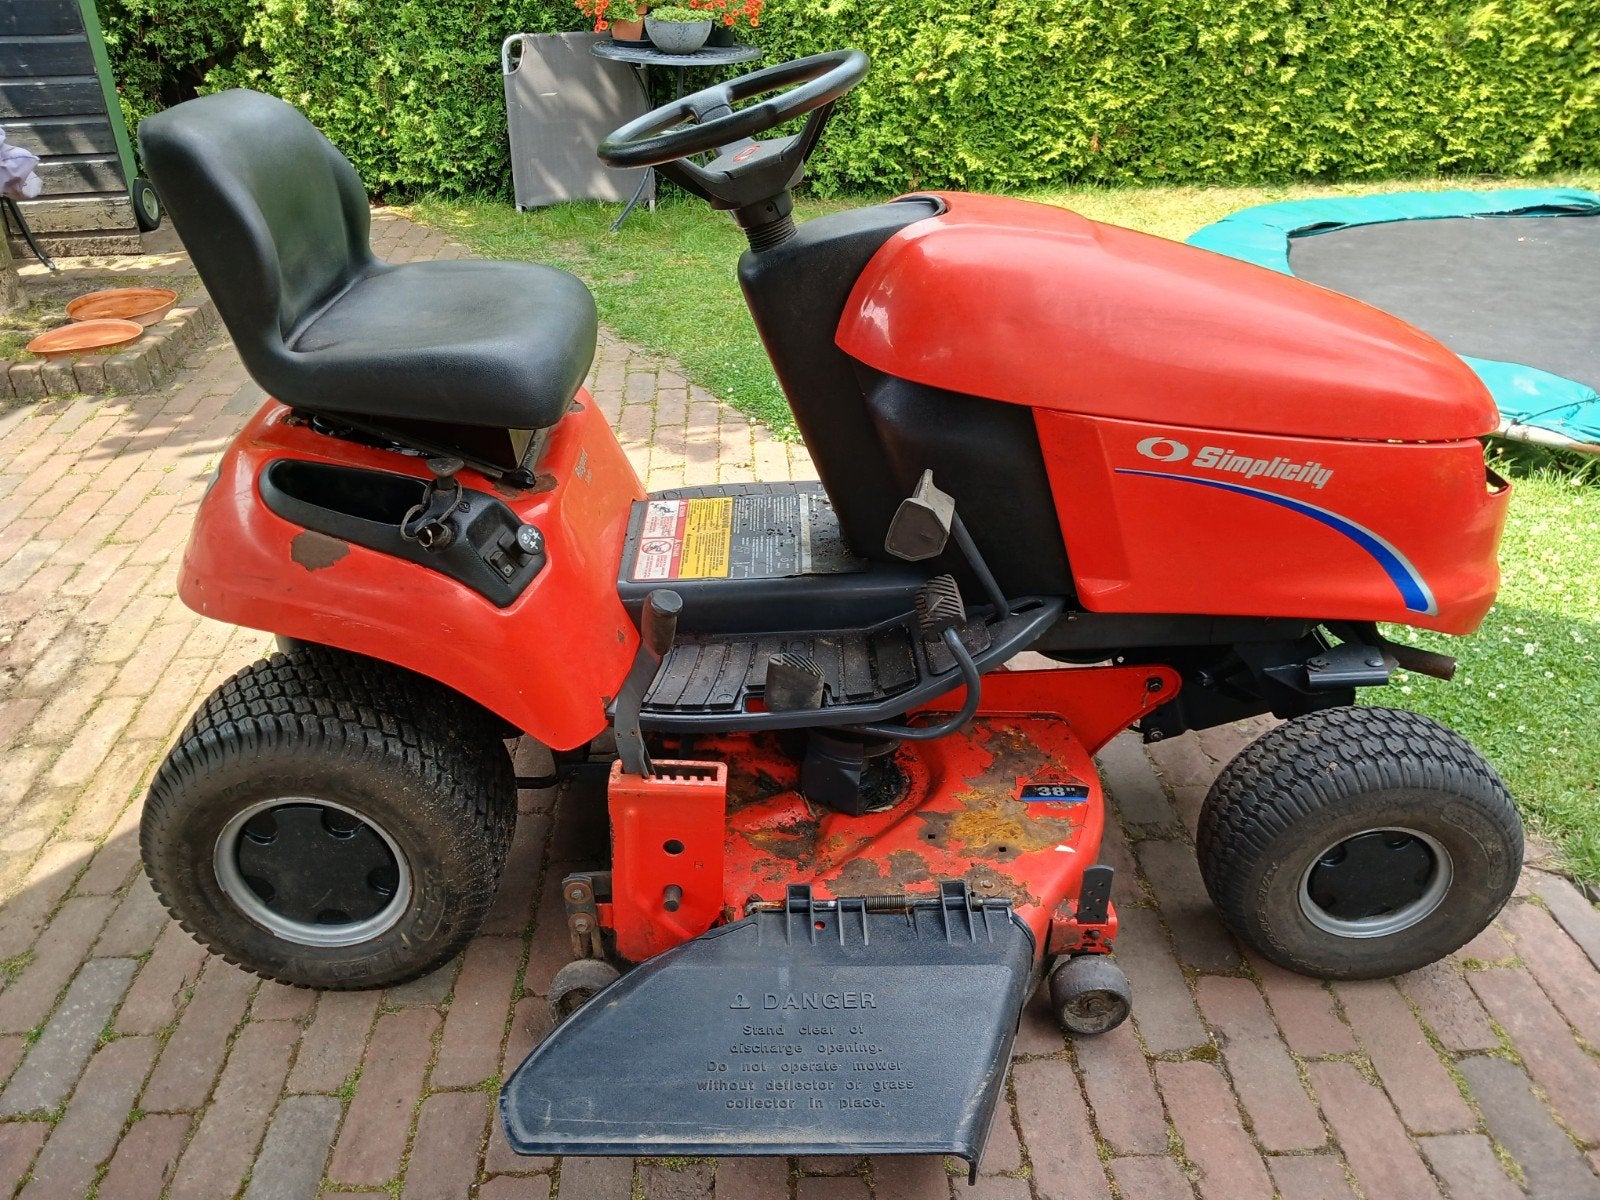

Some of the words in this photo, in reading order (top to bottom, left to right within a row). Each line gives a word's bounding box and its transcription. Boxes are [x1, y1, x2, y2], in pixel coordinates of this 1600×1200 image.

[1192, 446, 1334, 490] Simplicity
[1037, 786, 1076, 797] 38"
[763, 992, 877, 1010] DANGER
[742, 1025, 785, 1036] Stand
[798, 1025, 836, 1036] clear
[849, 1023, 864, 1035] of
[729, 1043, 803, 1056] discharge
[817, 1042, 883, 1056] opening.
[706, 1061, 728, 1072] Do
[742, 1061, 767, 1072] not
[781, 1061, 839, 1074] operate
[852, 1061, 902, 1071] mower
[696, 1078, 755, 1091] without
[765, 1078, 834, 1091] deflector
[845, 1080, 861, 1091] or
[872, 1080, 915, 1093] grass
[726, 1096, 796, 1110] collector
[809, 1096, 824, 1109] in
[839, 1096, 886, 1111] place.
